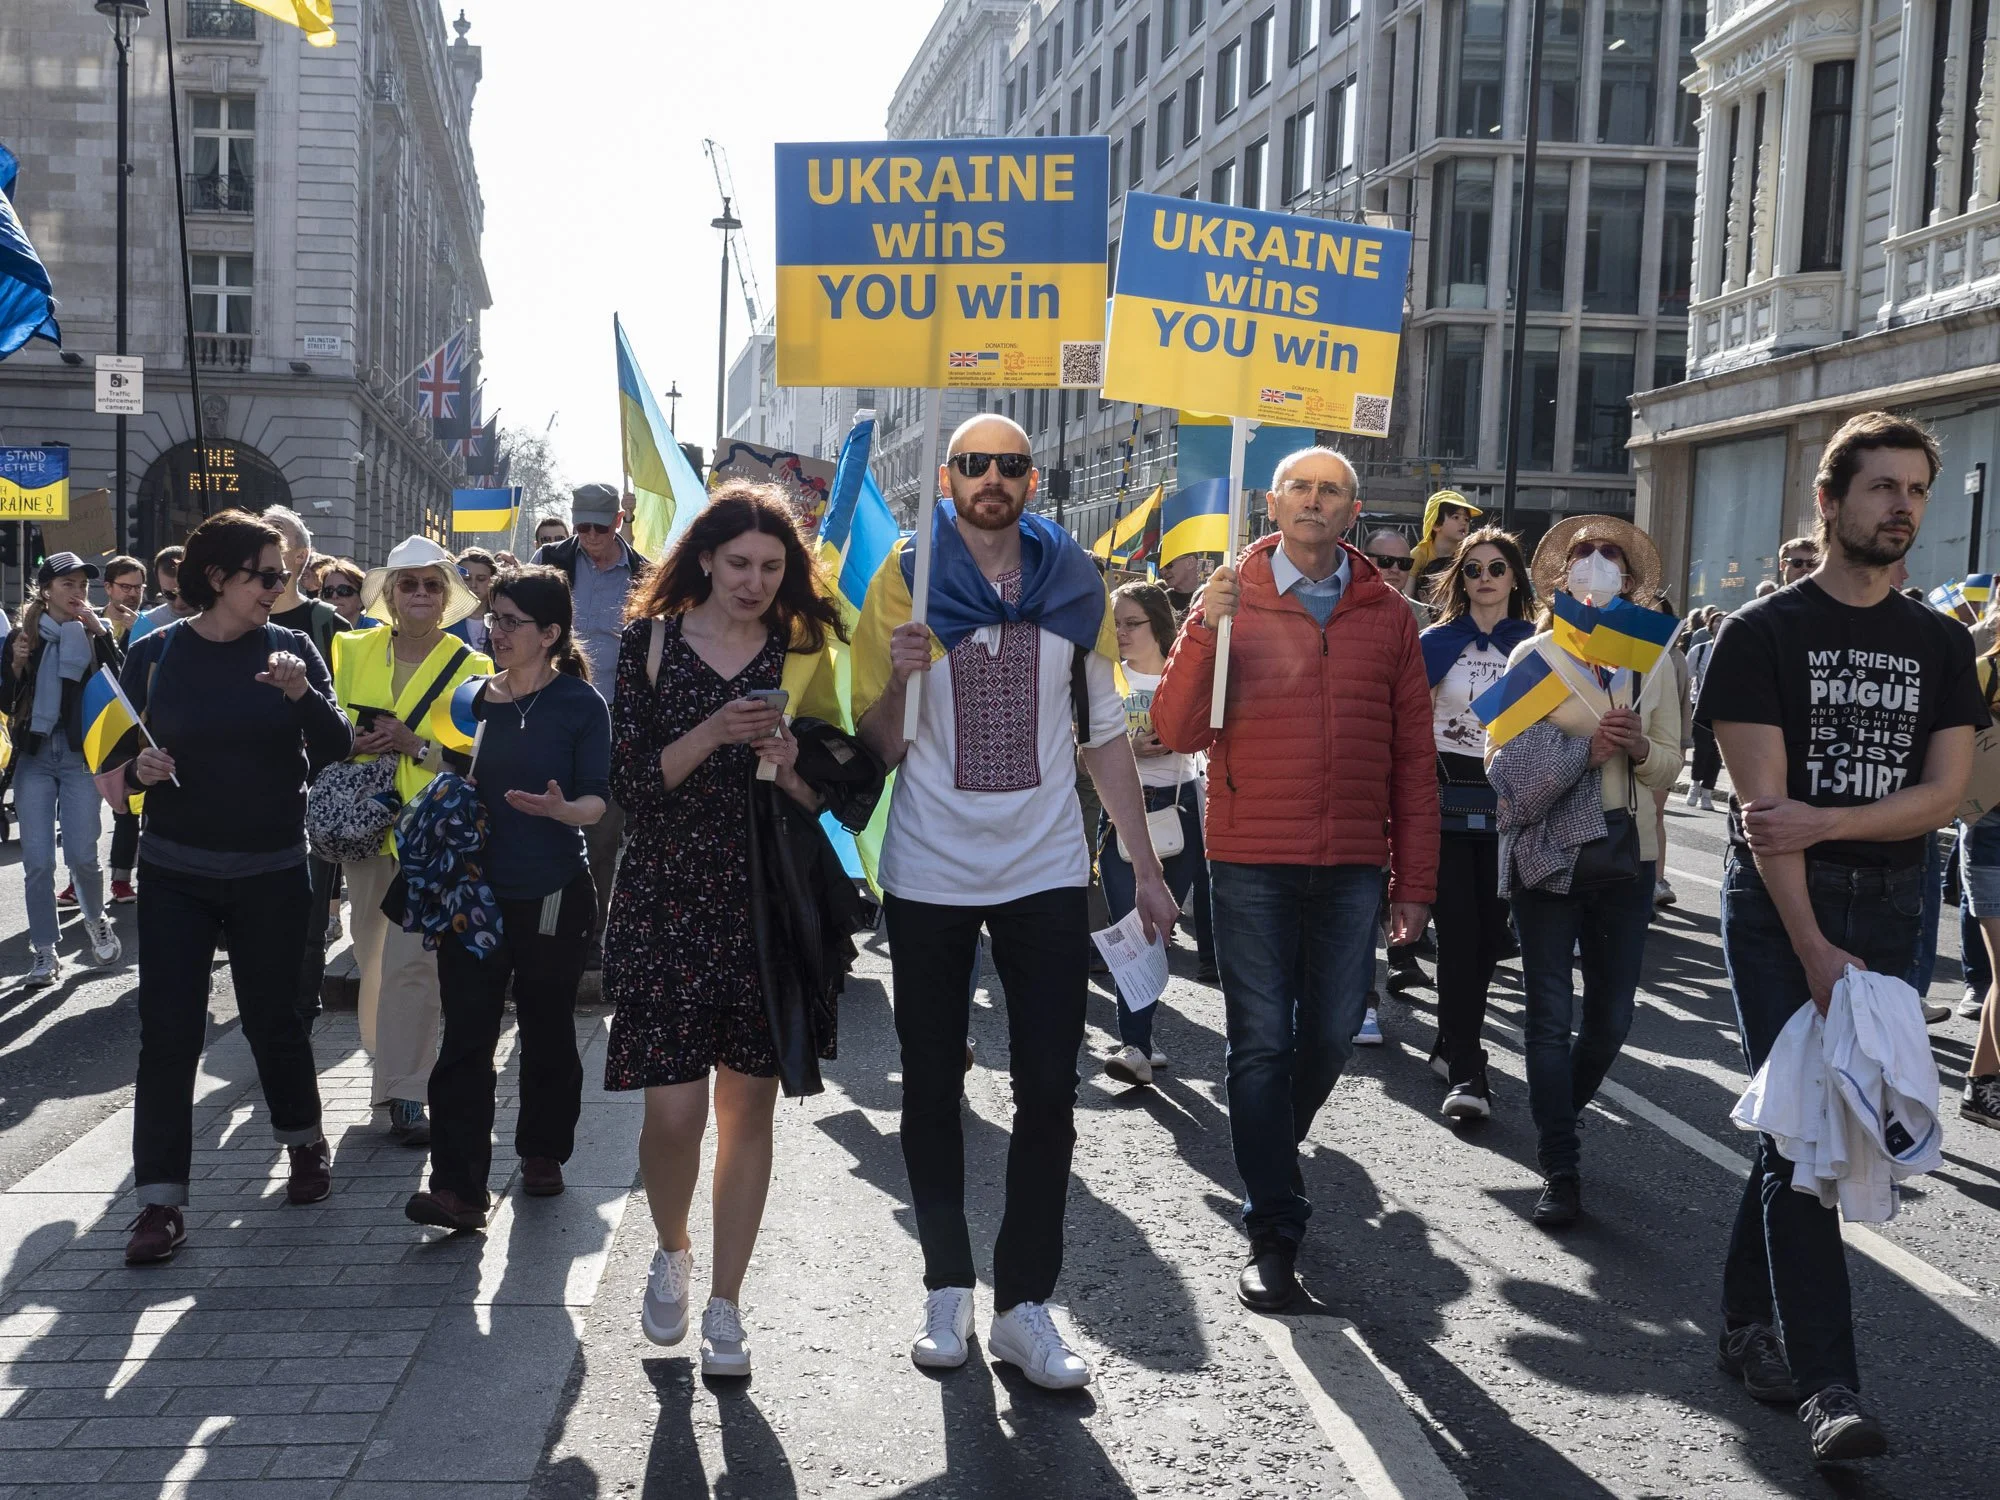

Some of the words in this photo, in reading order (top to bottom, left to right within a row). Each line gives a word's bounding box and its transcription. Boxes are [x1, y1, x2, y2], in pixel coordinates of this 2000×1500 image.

[808, 154, 1075, 205] UKRAINE
[872, 209, 1006, 258] wins
[1152, 209, 1383, 280] UKRAINE
[817, 273, 937, 320] YOU
[956, 271, 1060, 319] win
[1205, 267, 1319, 316] wins
[1152, 307, 1257, 358] YOU
[1273, 330, 1359, 374] win
[6, 450, 47, 463] STAND
[193, 449, 235, 467] HE
[190, 473, 239, 491] RITZ
[0, 495, 42, 513] RAINE
[1808, 650, 1841, 666] MY
[1848, 649, 1920, 674] FRIEND
[1810, 668, 1867, 679] WAS
[1890, 673, 1920, 687] IN
[1810, 678, 1920, 713] PRAGUE
[1811, 708, 1836, 716] AND
[1874, 711, 1917, 723] THING
[1811, 717, 1824, 725] HE
[1898, 723, 1915, 733] ME
[1811, 727, 1838, 740] IS
[1847, 725, 1913, 747] THIS
[1806, 758, 1908, 799] T-SHIRT
